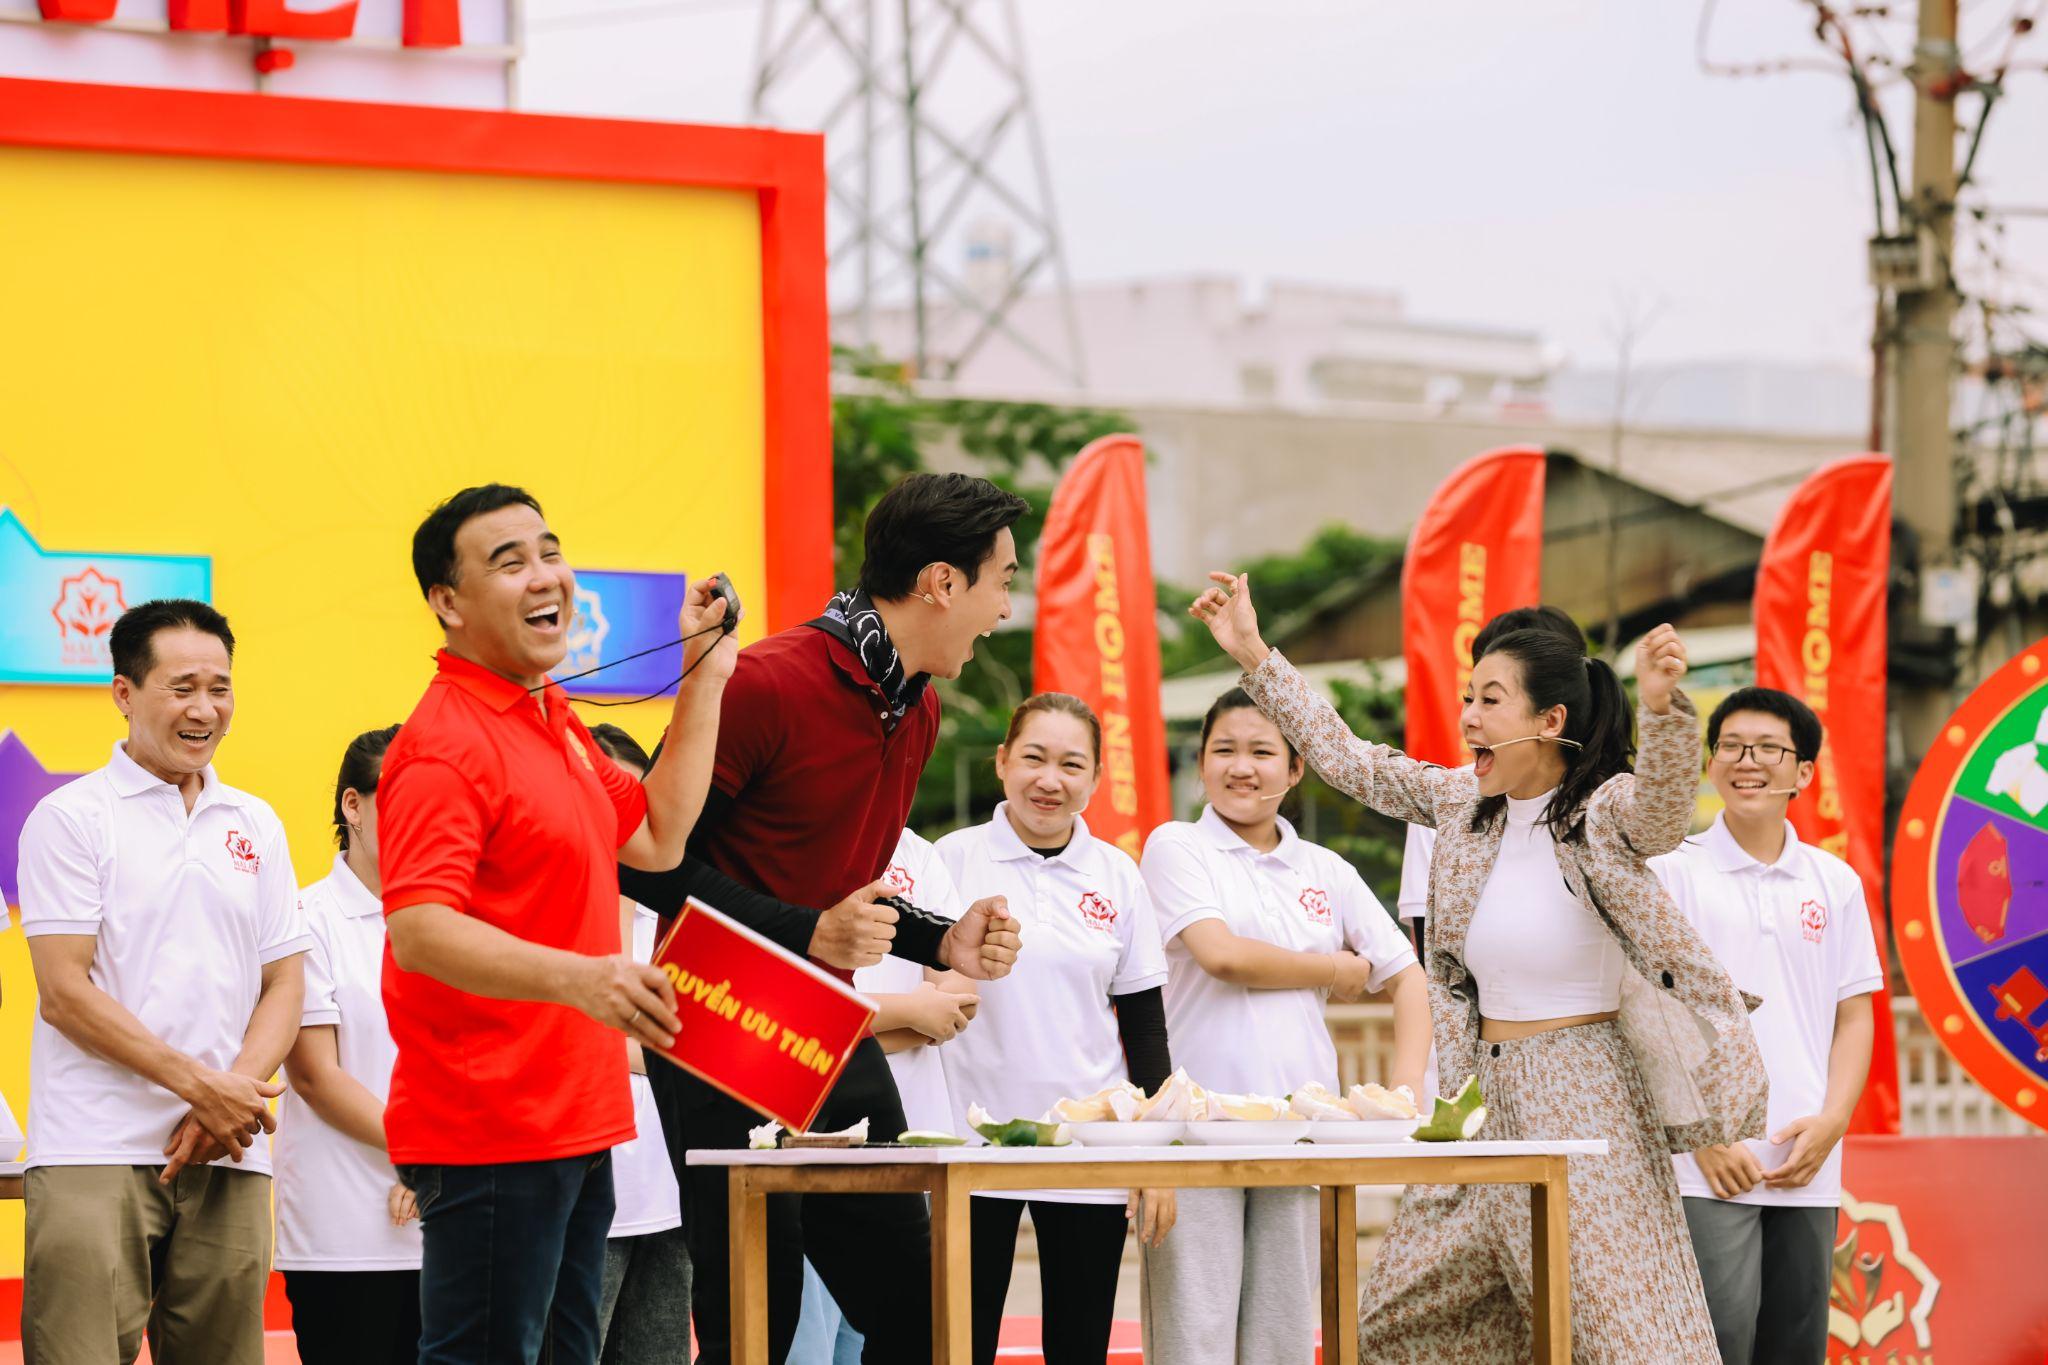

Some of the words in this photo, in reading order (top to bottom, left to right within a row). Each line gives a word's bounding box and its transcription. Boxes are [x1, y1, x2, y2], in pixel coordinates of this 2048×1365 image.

[1086, 533, 1128, 699] HOME
[1802, 550, 1833, 711] HOME
[1104, 711, 1138, 817] SEN
[1817, 726, 1844, 821] SE
[740, 1008, 778, 1041] ƯU
[779, 1029, 834, 1075] TIÊN
